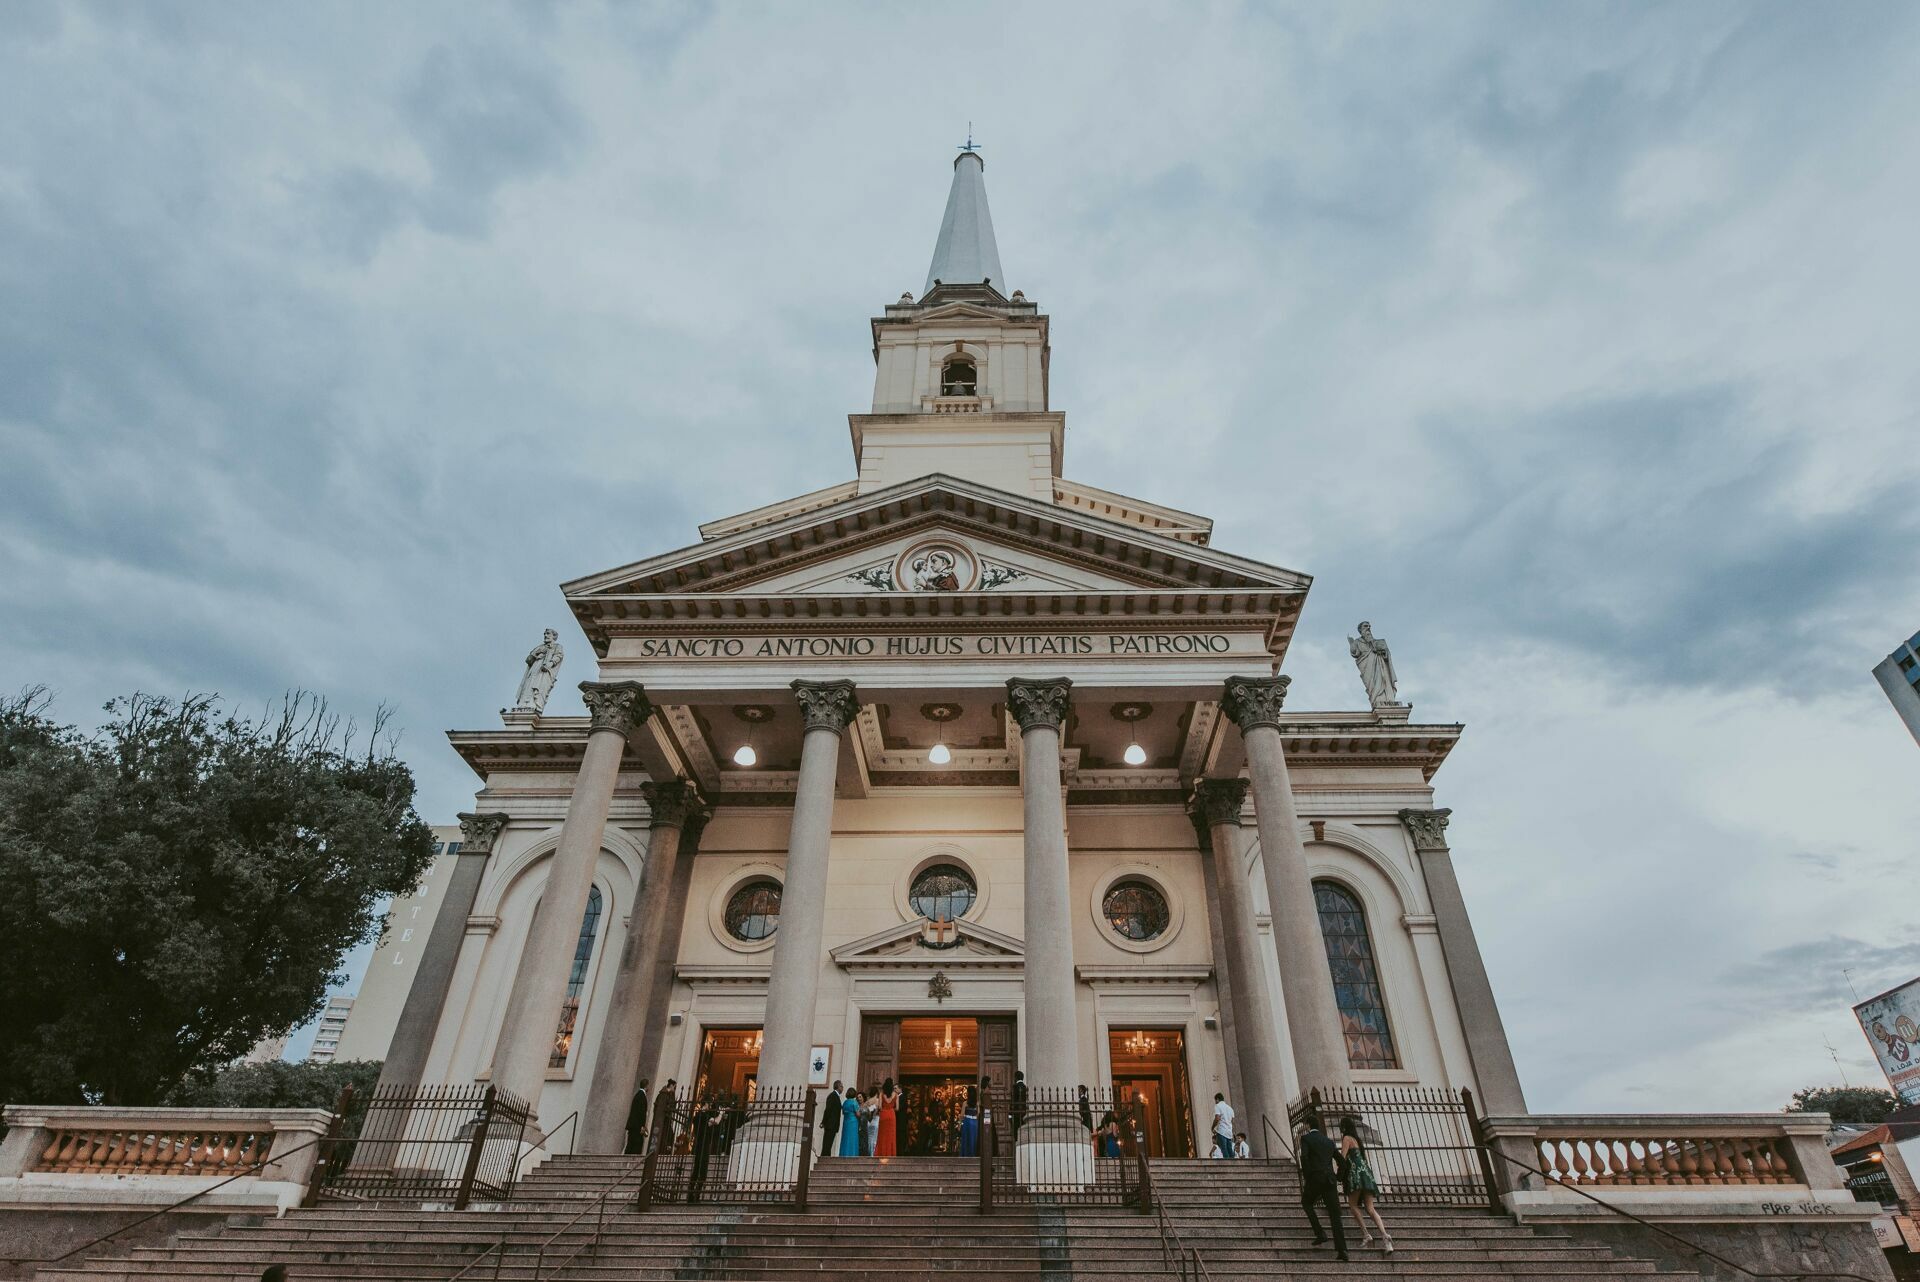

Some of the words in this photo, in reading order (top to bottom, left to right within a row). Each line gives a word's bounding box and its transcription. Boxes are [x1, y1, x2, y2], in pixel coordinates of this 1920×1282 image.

[640, 638, 744, 657] SANCTO
[756, 637, 875, 657] ANTONIO
[886, 636, 963, 656] HUJUS
[976, 635, 1093, 655] CIVITATIS
[1108, 634, 1230, 654] PATRONO
[1896, 1060, 1913, 1071] LOJA
